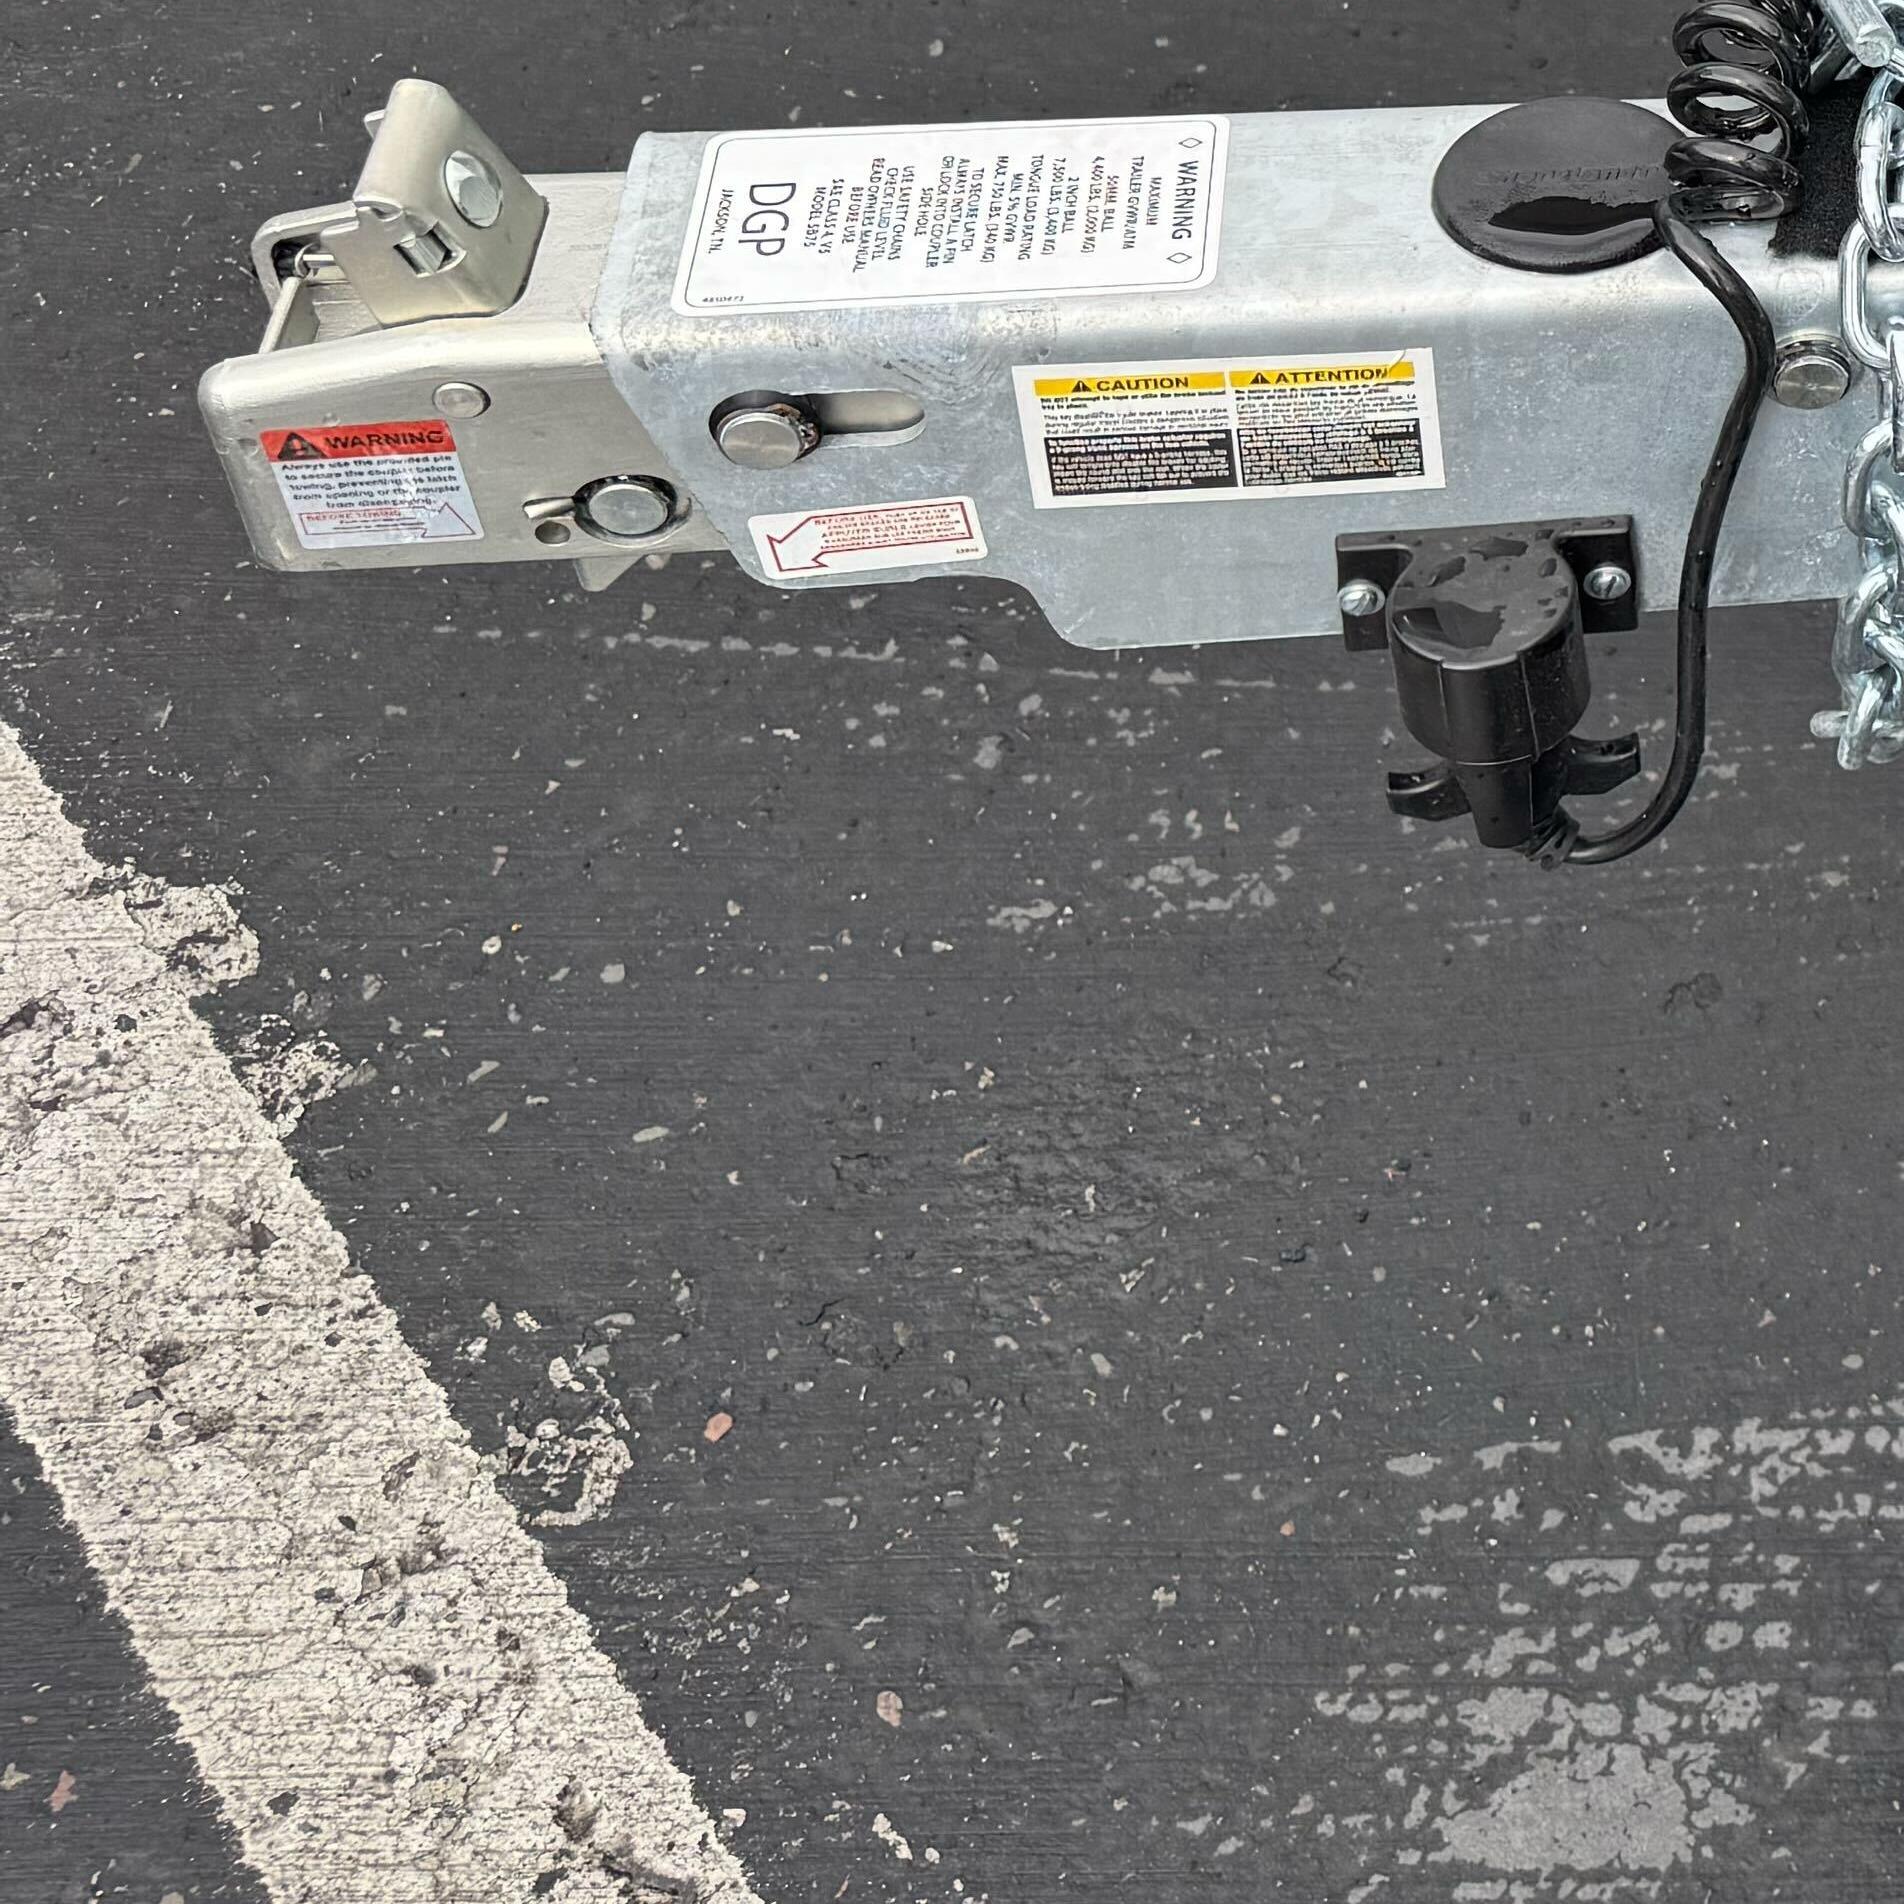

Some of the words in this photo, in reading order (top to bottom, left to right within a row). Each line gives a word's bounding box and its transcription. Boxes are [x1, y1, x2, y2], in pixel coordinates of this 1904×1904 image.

[867, 157, 886, 183] READ
[881, 167, 899, 198] CHECK
[900, 165, 916, 183] USE
[936, 170, 953, 195] LOCK
[970, 167, 985, 180] TO
[1024, 154, 1046, 193] TONGUE
[1125, 155, 1146, 194] TRAILER
[808, 186, 827, 220] MODEL
[844, 186, 864, 222] BEFORE
[893, 186, 912, 221] SAFETY
[917, 187, 934, 208] SIDE
[964, 182, 983, 218] SECURE
[1021, 196, 1039, 222] LOAD
[1063, 184, 1080, 207] INCH
[1142, 176, 1165, 226] MAXIMUM
[1166, 159, 1202, 241] WARNING
[734, 182, 797, 257] DGP
[822, 198, 841, 228] CLASS
[876, 201, 893, 228] FLUID
[932, 198, 948, 221] INTO
[1060, 209, 1077, 233] BALL
[1099, 208, 1116, 232] BALL
[840, 225, 857, 245] USE
[913, 210, 931, 237] HOLE
[959, 221, 977, 252] LATCH
[851, 229, 872, 273] MANUAL
[870, 231, 888, 260] LEVEL
[886, 224, 906, 261] CHAINS
[923, 223, 945, 268] COUPLER
[1016, 224, 1035, 261] RATING
[1096, 377, 1189, 392] CAUTION
[1276, 368, 1388, 384] ATTENTION
[325, 431, 445, 449] WARNING
[301, 472, 342, 480] secure
[344, 469, 365, 477] the
[416, 465, 455, 474] before
[353, 458, 373, 466] the
[433, 455, 453, 464] pin
[378, 488, 391, 497] or
